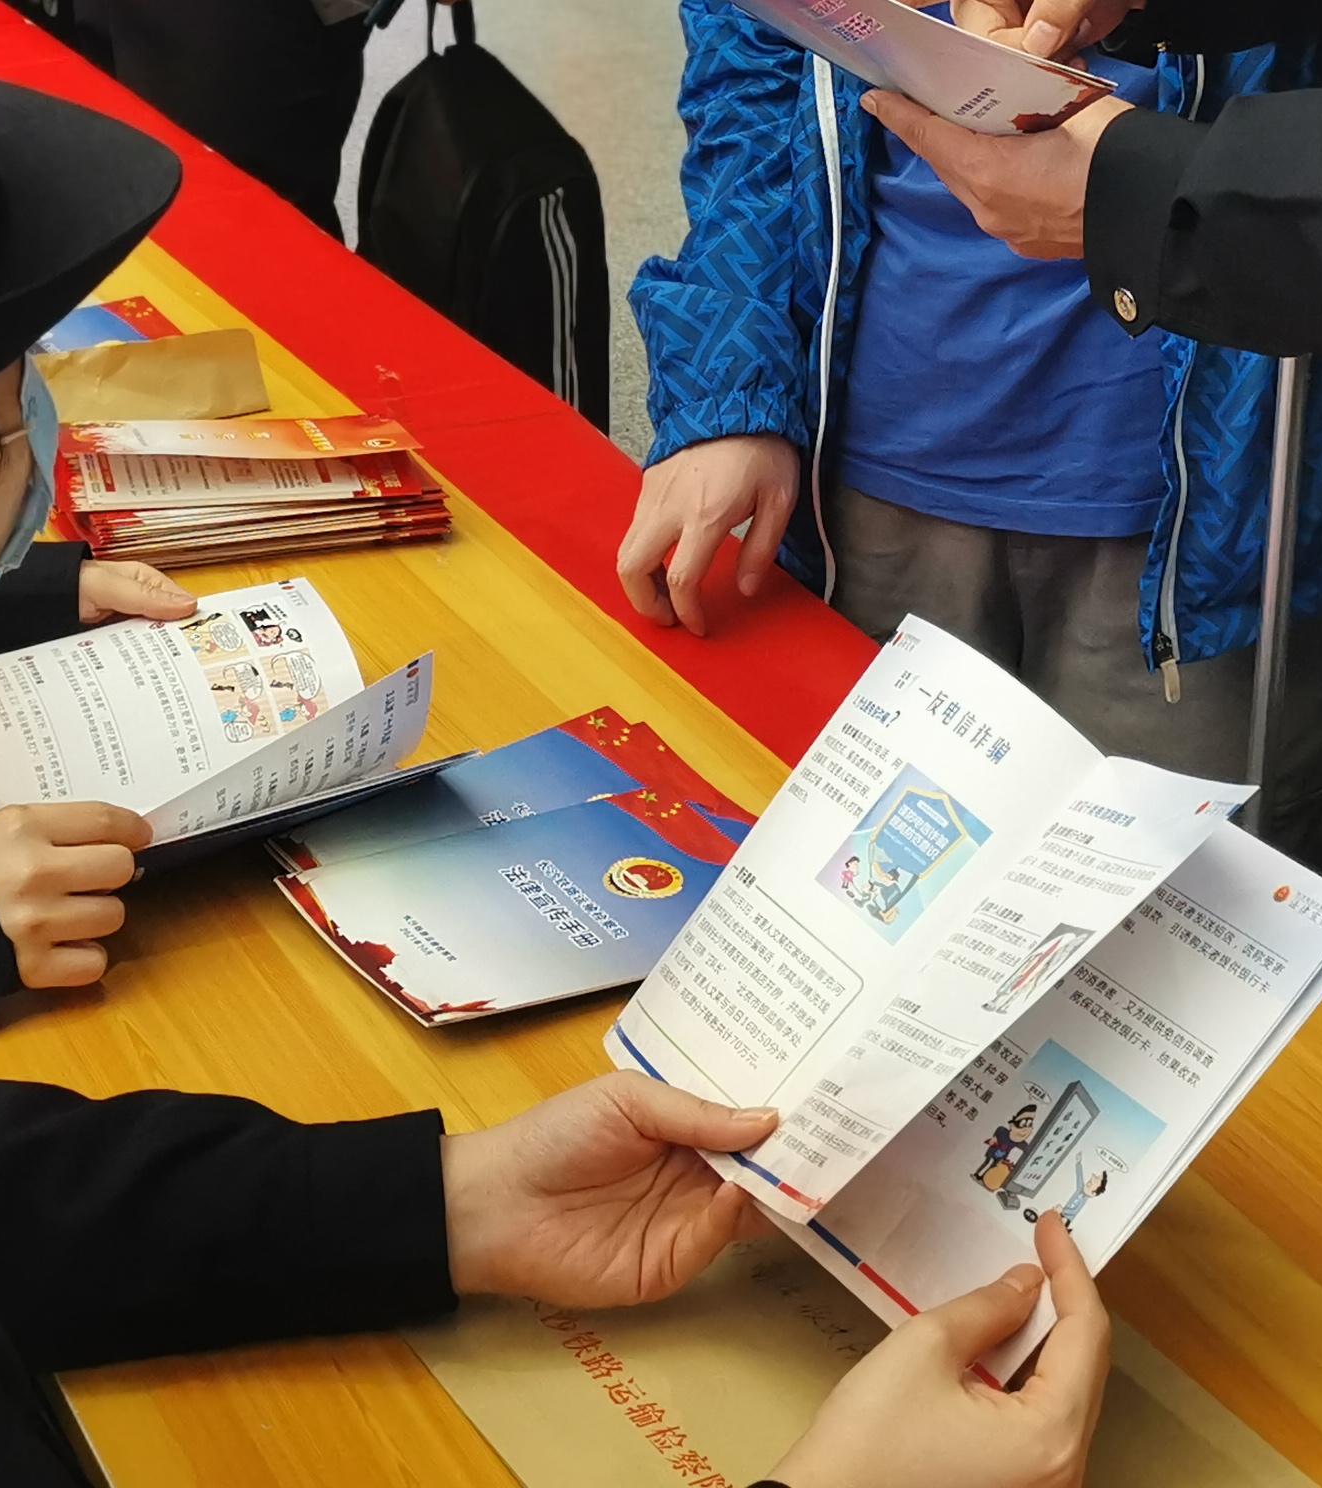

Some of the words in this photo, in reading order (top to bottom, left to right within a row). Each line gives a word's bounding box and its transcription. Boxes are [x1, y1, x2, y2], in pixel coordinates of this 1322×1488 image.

[498, 864, 604, 950] 法律宣传手册
